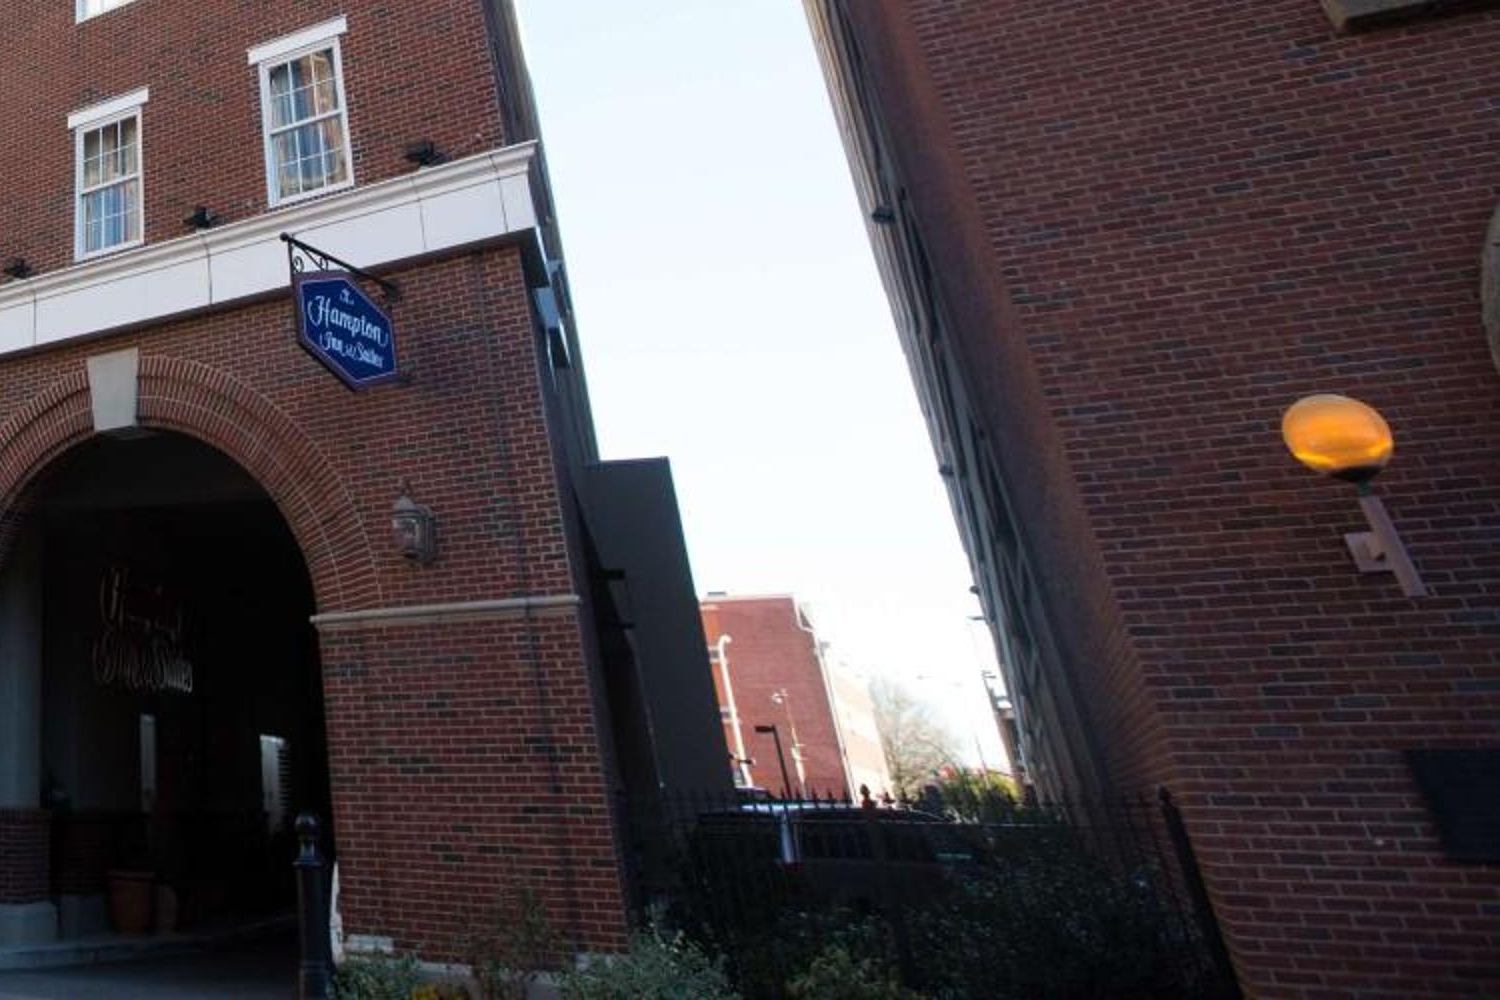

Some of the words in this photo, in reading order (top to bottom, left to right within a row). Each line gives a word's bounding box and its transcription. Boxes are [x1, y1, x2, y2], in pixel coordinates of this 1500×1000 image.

[307, 295, 389, 347] Hampton
[319, 331, 343, 350] Inn
[355, 341, 384, 368] Suites
